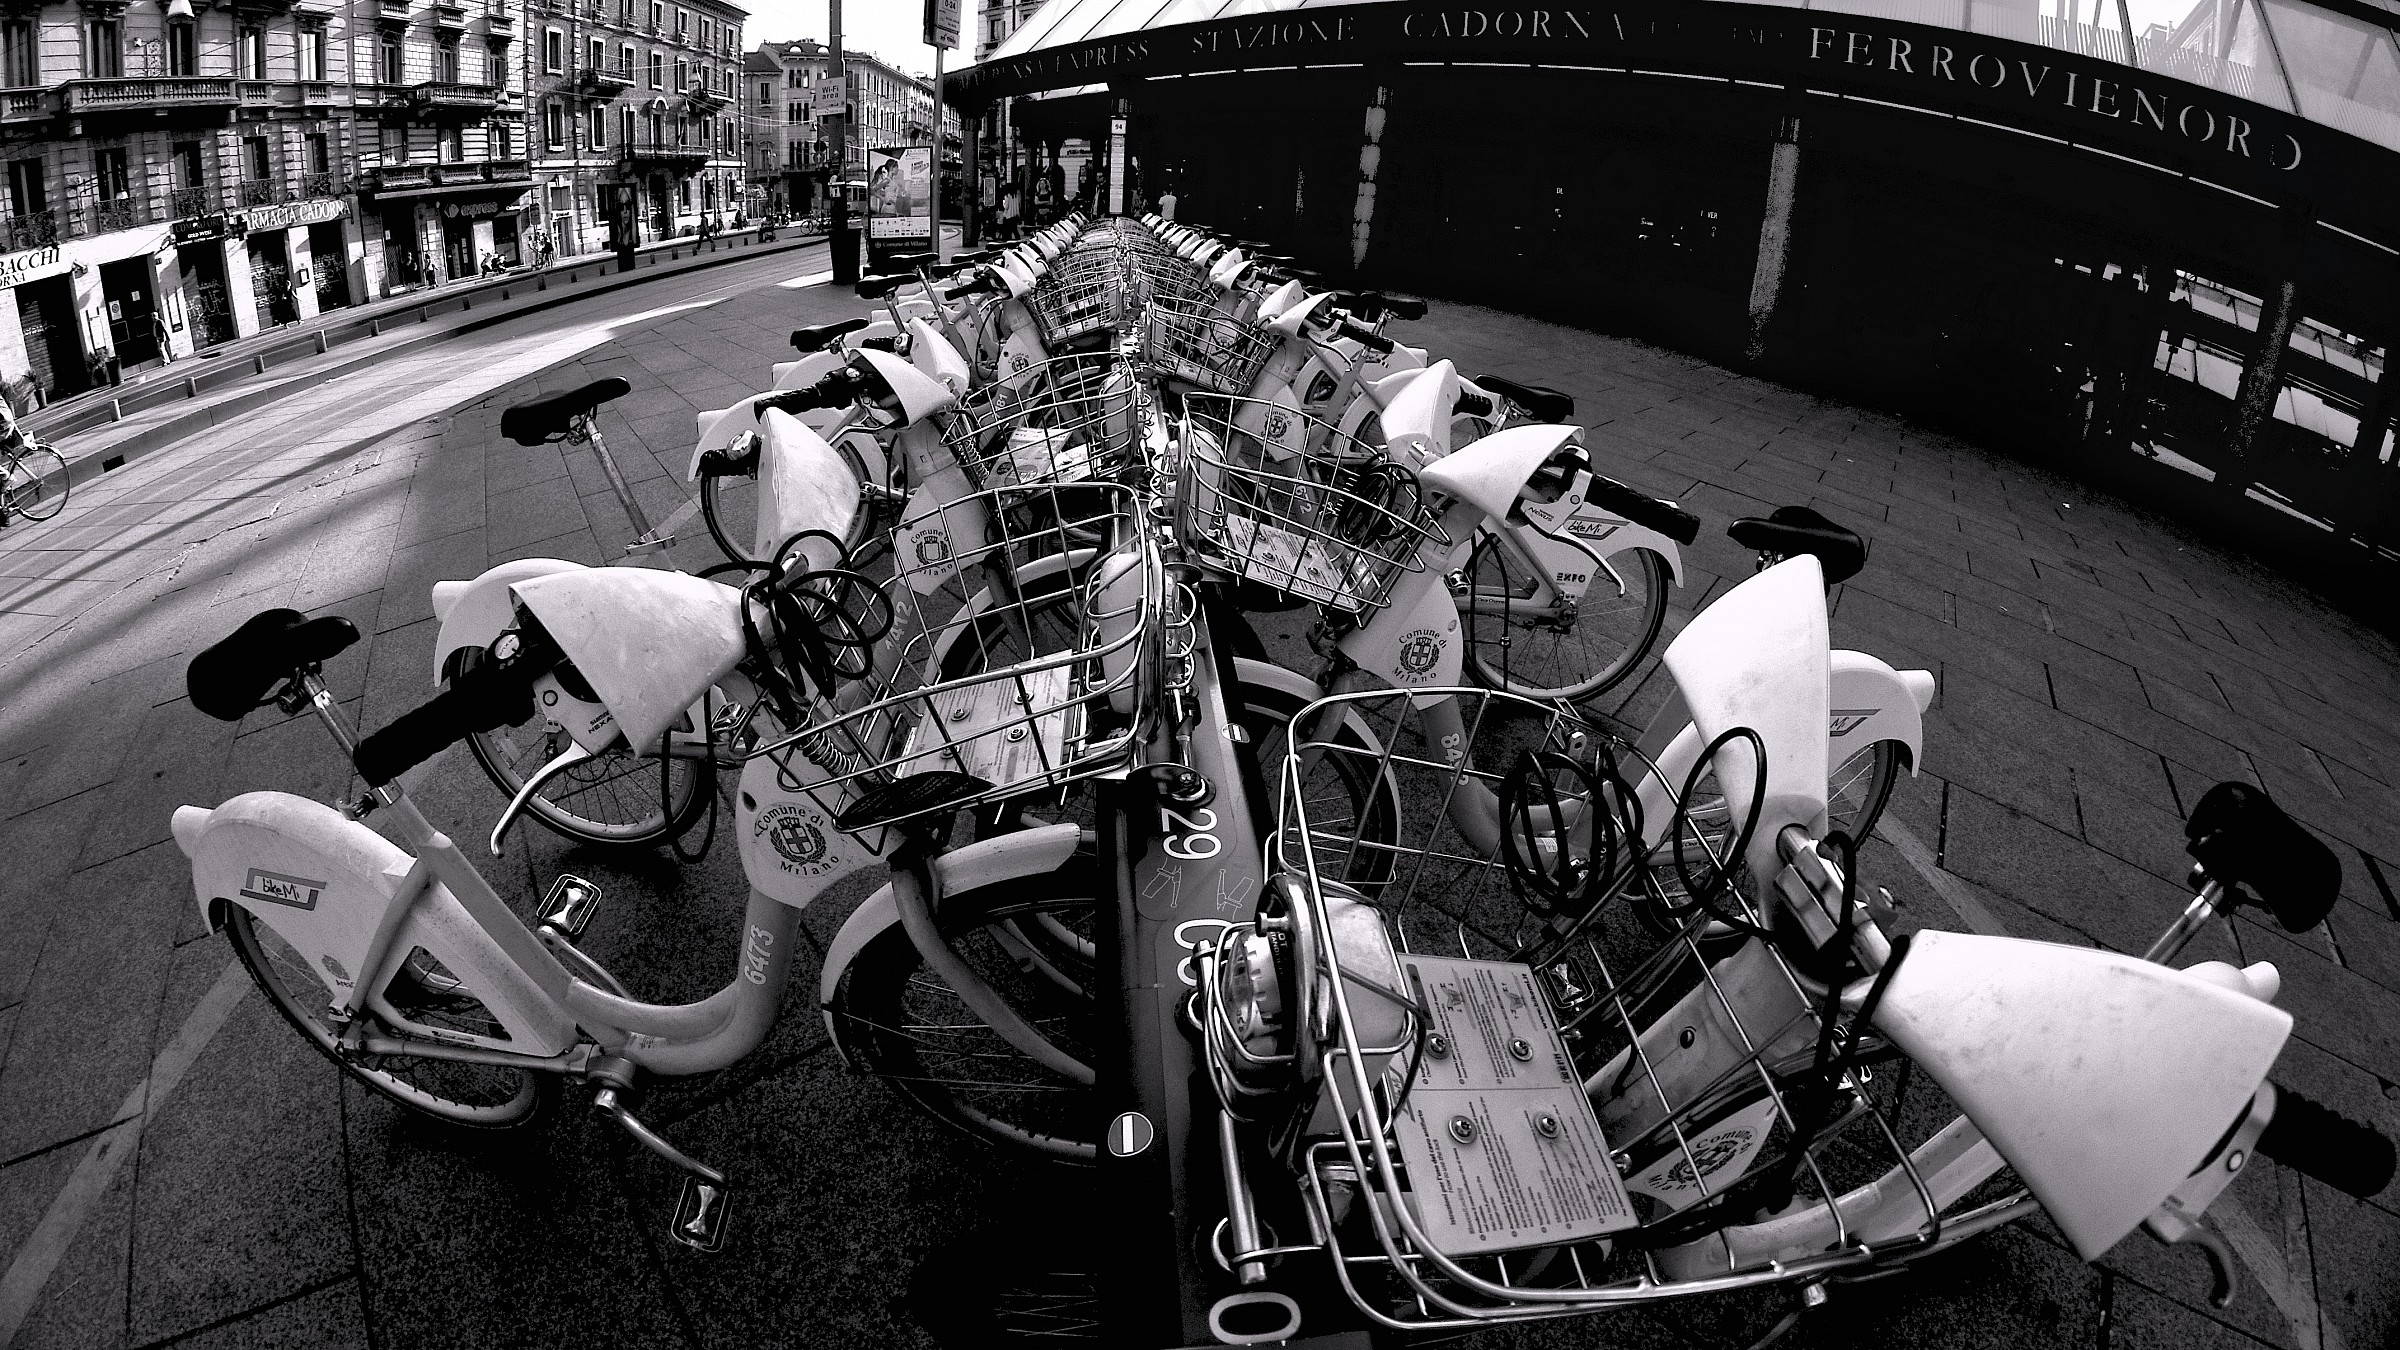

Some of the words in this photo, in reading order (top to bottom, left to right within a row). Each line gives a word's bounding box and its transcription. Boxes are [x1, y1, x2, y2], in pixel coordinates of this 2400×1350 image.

[1193, 17, 1354, 53] STAZIONE
[1810, 27, 2302, 170] FERROVIENORD
[243, 205, 297, 234] ARMACIA
[1556, 572, 1586, 583] EXPO
[1399, 628, 1441, 644] Comune
[1438, 639, 1447, 649] di
[1392, 666, 1437, 684] Milano
[755, 805, 807, 838] Comune
[1161, 807, 1222, 860] 29
[780, 855, 840, 877] Milano
[744, 924, 774, 985] 6473
[1521, 973, 1548, 1029] www.bikemi.it
[1438, 1182, 1448, 1192] per
[1441, 1194, 1456, 1225] Istruzioni
